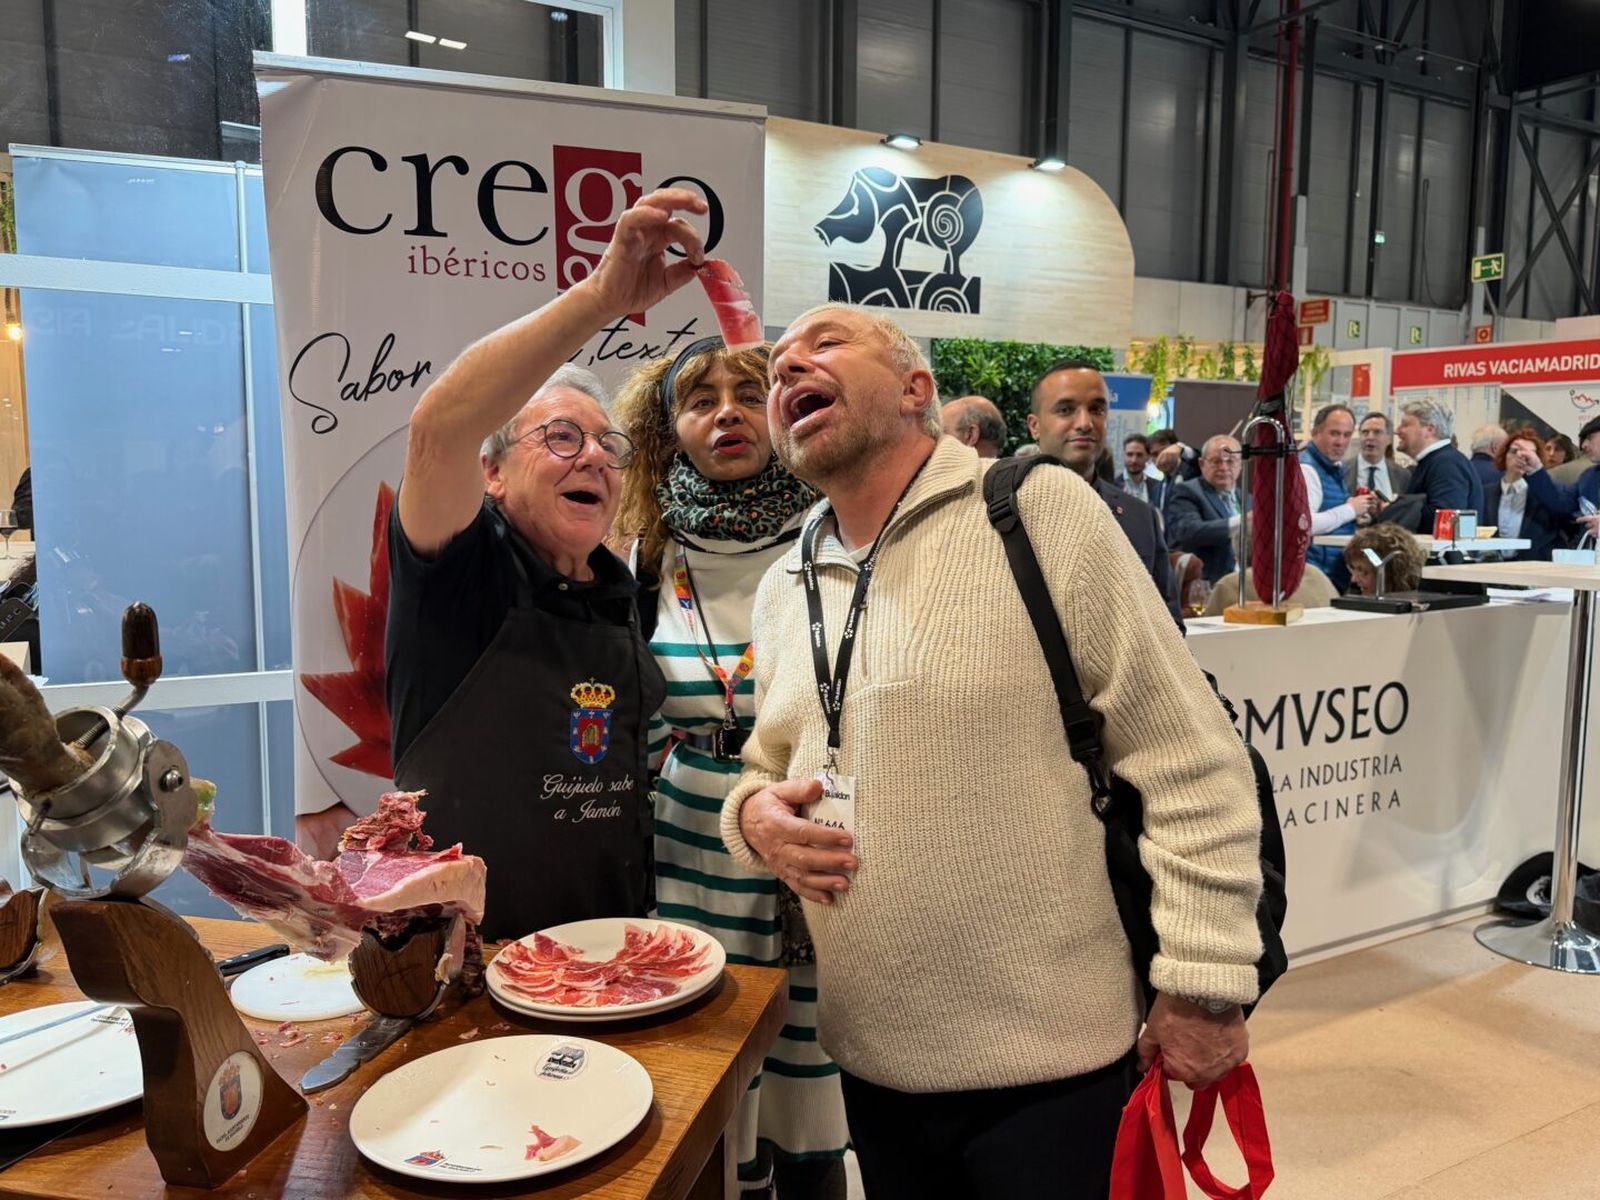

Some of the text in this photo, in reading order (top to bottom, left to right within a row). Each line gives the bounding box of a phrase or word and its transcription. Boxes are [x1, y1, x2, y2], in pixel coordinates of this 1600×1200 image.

[314, 146, 725, 288] crego
[407, 245, 547, 282] ibéricos
[288, 331, 432, 435] Sabor
[1443, 353, 1600, 379] RIVAS VACIAMADRID
[1243, 681, 1409, 750] MVSEO
[540, 773, 635, 800] Guijuelo sabe
[1271, 753, 1403, 795] LA INDUSTRIA
[553, 798, 622, 824] a Jamón
[1282, 789, 1401, 830] ACINERA
